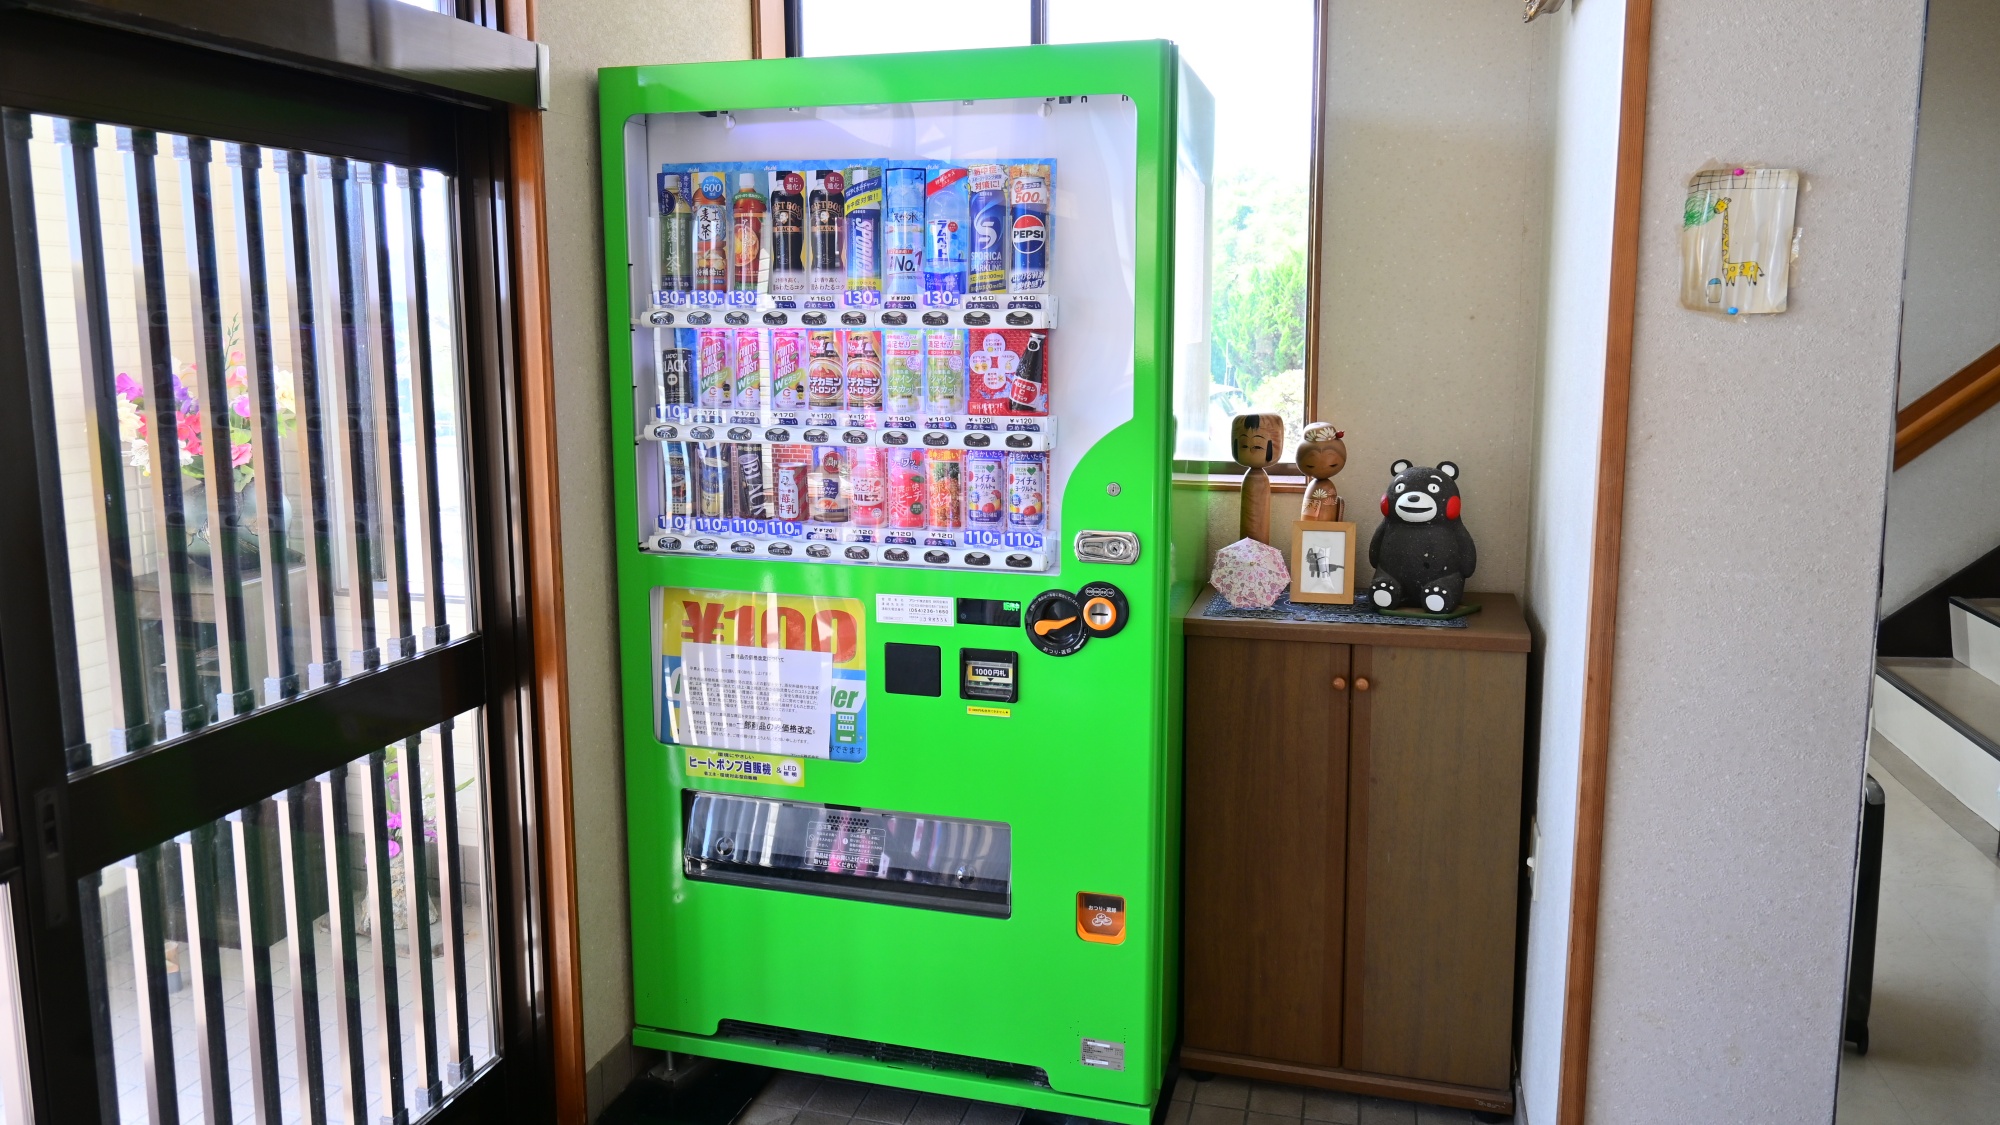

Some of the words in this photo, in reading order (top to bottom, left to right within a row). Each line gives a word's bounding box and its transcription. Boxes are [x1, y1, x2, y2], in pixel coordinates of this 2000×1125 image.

[703, 183, 722, 192] 600
[1014, 191, 1041, 203] 500
[700, 208, 711, 239] 麦茶
[1013, 228, 1044, 238] PEPSI
[970, 251, 1002, 260] SPORICA
[655, 290, 686, 304] 130円
[691, 290, 723, 304] 130円
[845, 290, 880, 304] 130円
[924, 290, 959, 305] 130円
[743, 461, 765, 516] BLACK
[853, 493, 879, 502] カルピス
[697, 518, 728, 531] 110円
[733, 520, 764, 533] 110円
[769, 521, 801, 535] 110円
[966, 530, 999, 545] 110円
[1007, 532, 1041, 547] 110円
[682, 600, 858, 664] ¥100
[975, 668, 1007, 677] 1000円札
[689, 755, 772, 776] ヒートポンプ自販機
